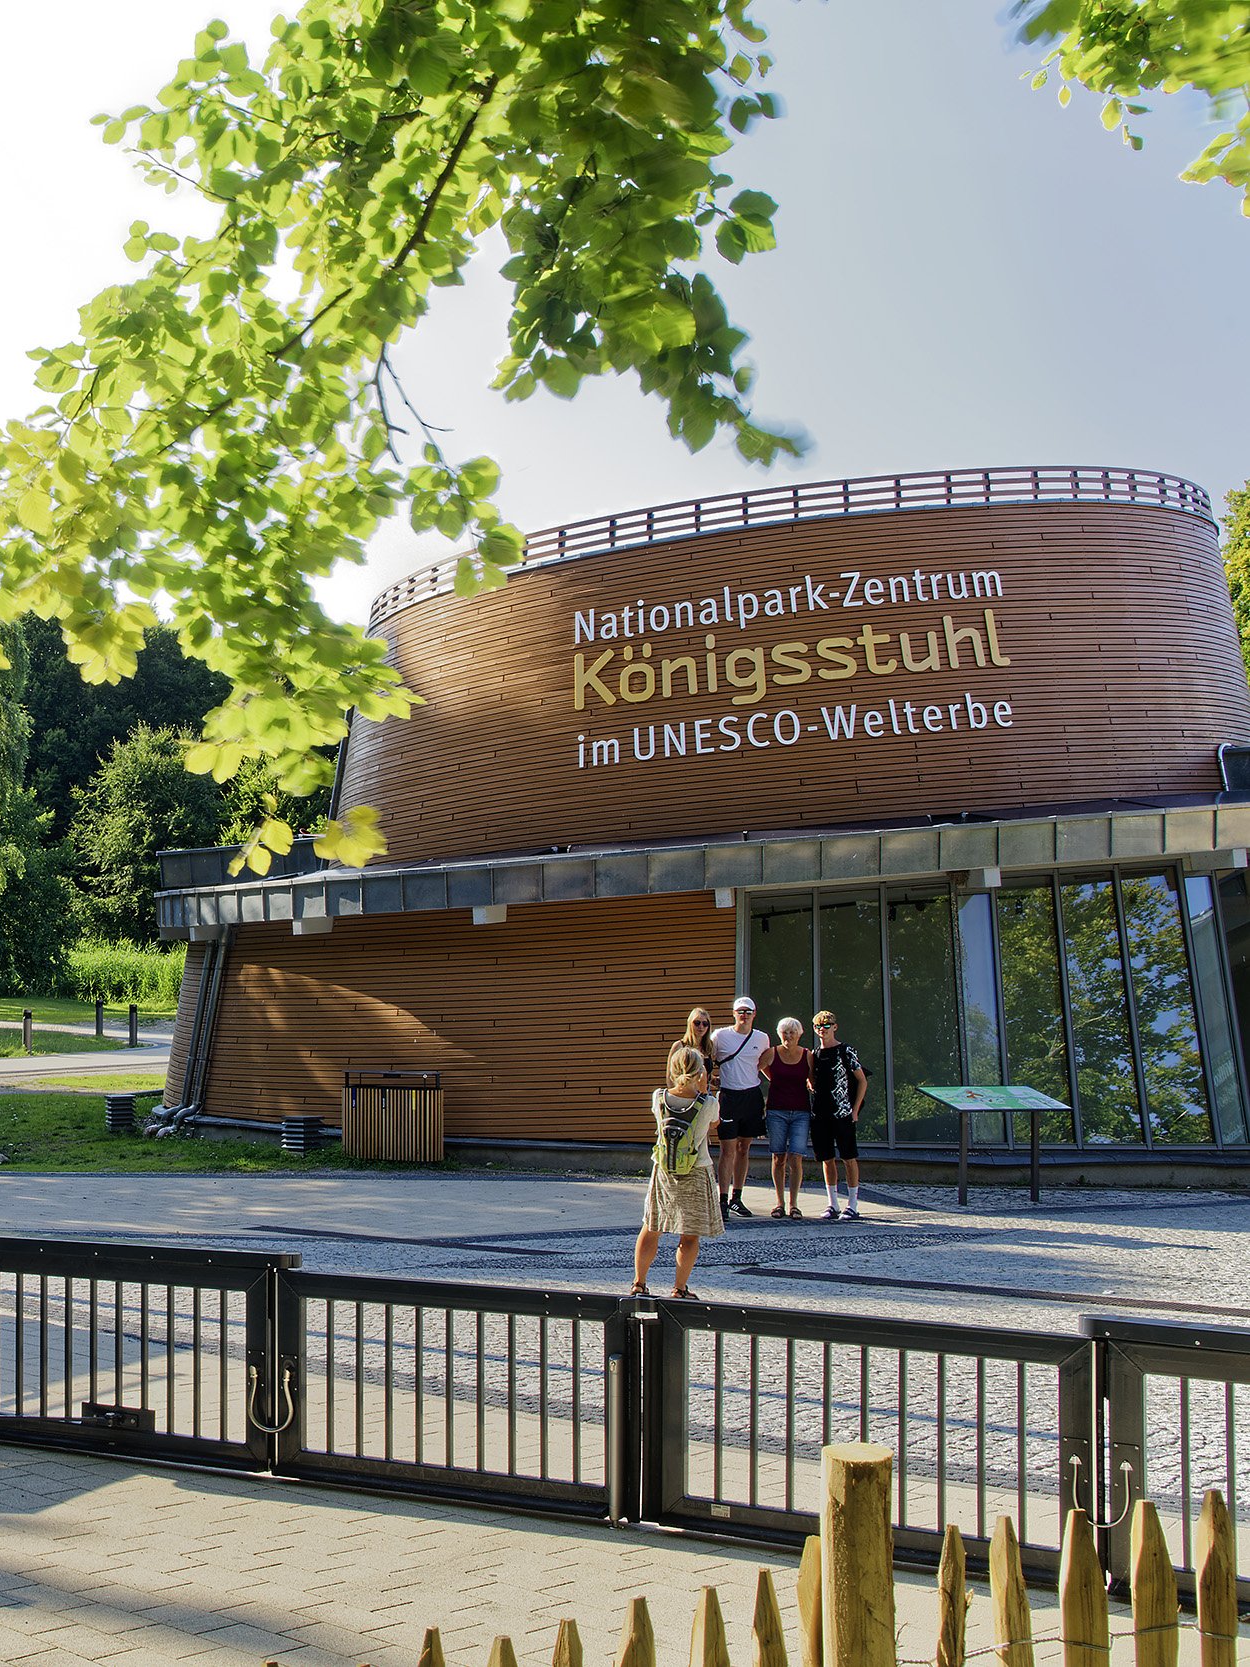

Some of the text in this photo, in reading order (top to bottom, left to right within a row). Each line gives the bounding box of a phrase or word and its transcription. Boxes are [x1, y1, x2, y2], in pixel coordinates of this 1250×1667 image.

[573, 569, 1004, 645] Nationalpark-Zentrum
[573, 608, 1011, 711] Königsstuhl
[577, 692, 1014, 769] im UNESCO-Welterbe
